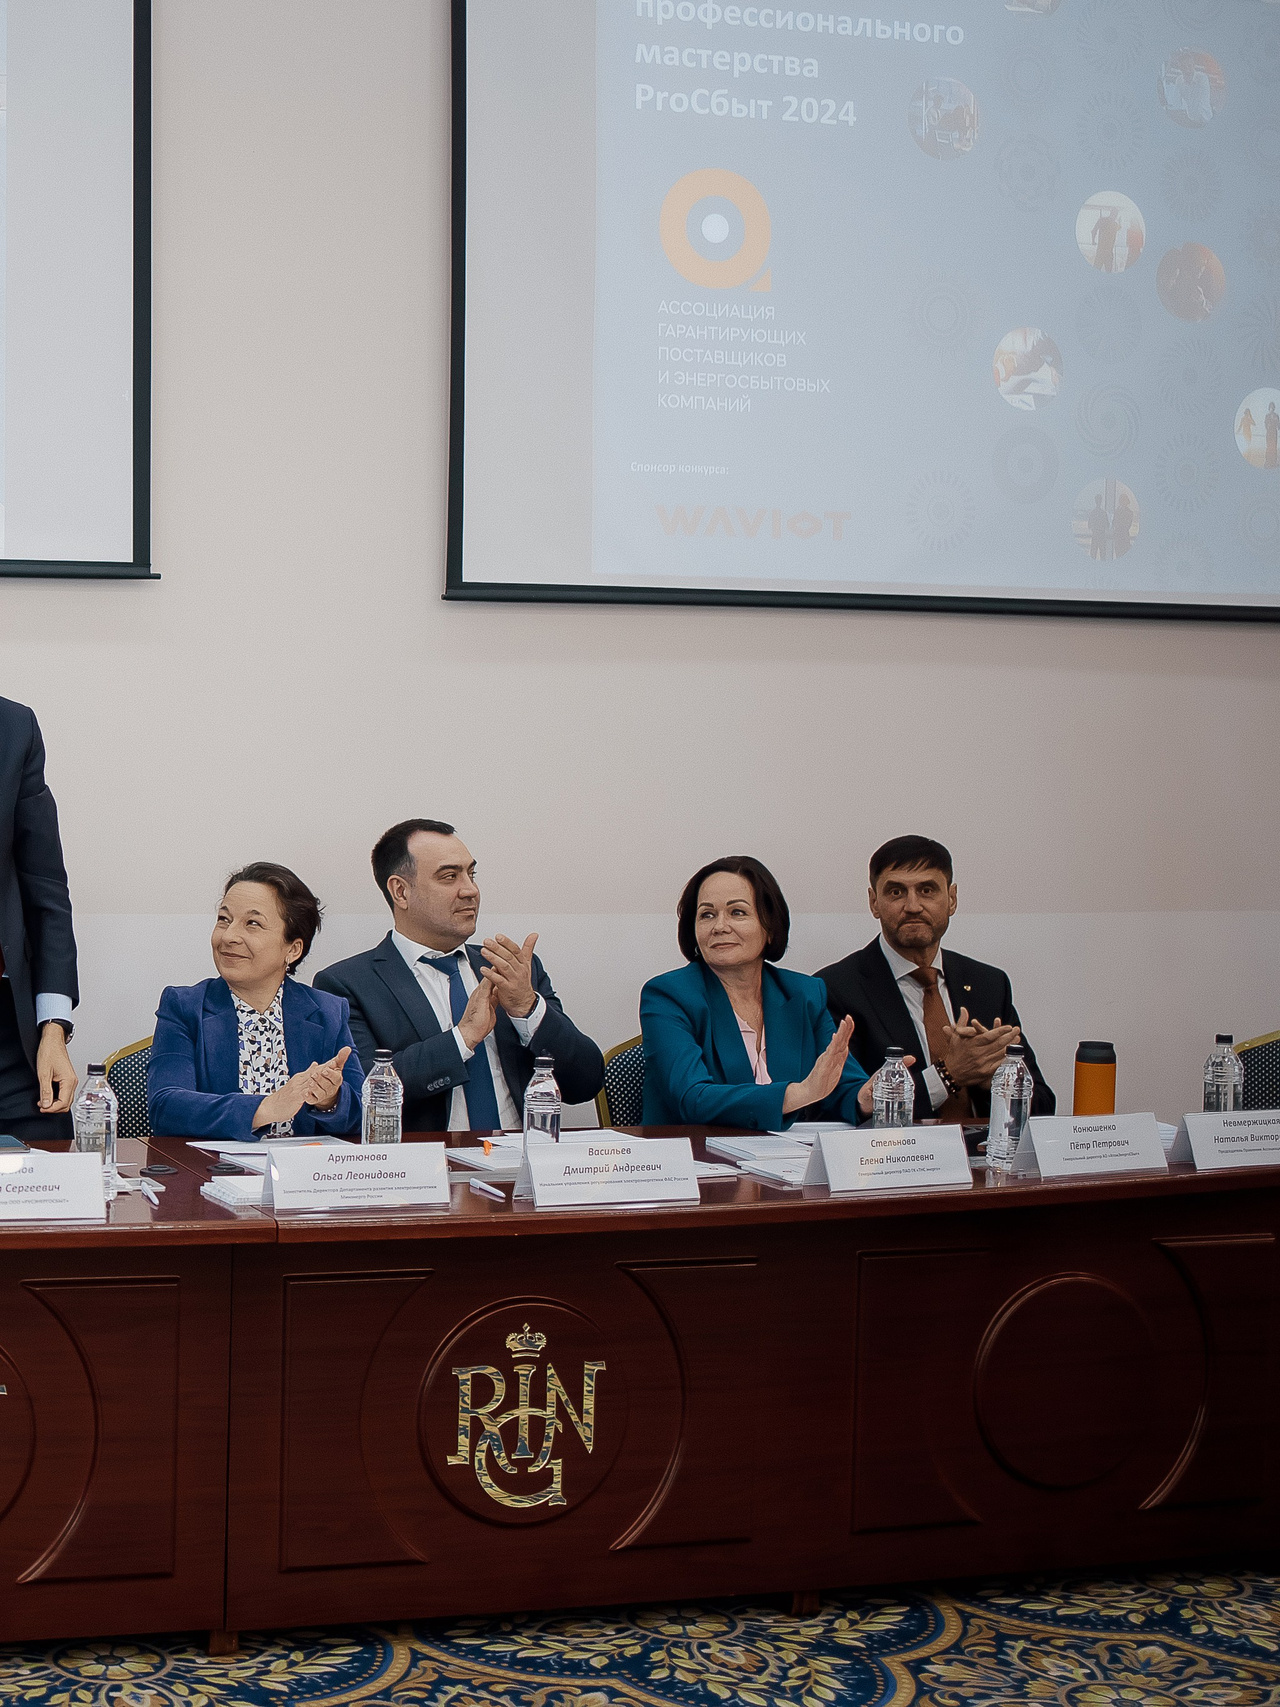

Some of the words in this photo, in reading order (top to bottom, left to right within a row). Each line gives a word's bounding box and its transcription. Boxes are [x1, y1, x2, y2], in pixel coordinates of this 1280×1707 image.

[635, 0, 965, 46] профессионального
[635, 43, 819, 78] мастерства
[781, 95, 857, 127] 2024
[658, 299, 775, 322] АССОЦИАЦИЯ
[658, 323, 807, 347] ГАРАНТИРУЮЩИХ
[658, 346, 787, 368] ПОСТАВЩИКОВ
[657, 370, 670, 385] И
[673, 371, 831, 394] ЭНЕРГОСБЫТОВЫХ
[657, 393, 751, 413] КОМПАНИЙ
[630, 461, 676, 475] Спонсор
[678, 464, 729, 477] конкурса:
[654, 503, 852, 541] WAVIOT
[1072, 1122, 1117, 1135] Конюшенко
[870, 1137, 917, 1149] Стельнова
[1092, 1138, 1130, 1151] Петрович
[1213, 1135, 1249, 1144] Наталья
[1250, 1133, 1280, 1143] Виктор
[327, 1152, 388, 1164] Арутюнова
[588, 1146, 632, 1157] Васильев
[859, 1155, 884, 1166] Елена
[886, 1152, 935, 1164] Николаевна
[312, 1171, 343, 1183] Ольга
[345, 1169, 407, 1181] Леонидовна
[563, 1163, 610, 1177] Дмитрий
[612, 1161, 662, 1174] Андреевич
[5, 1183, 61, 1195] Сергеевич
